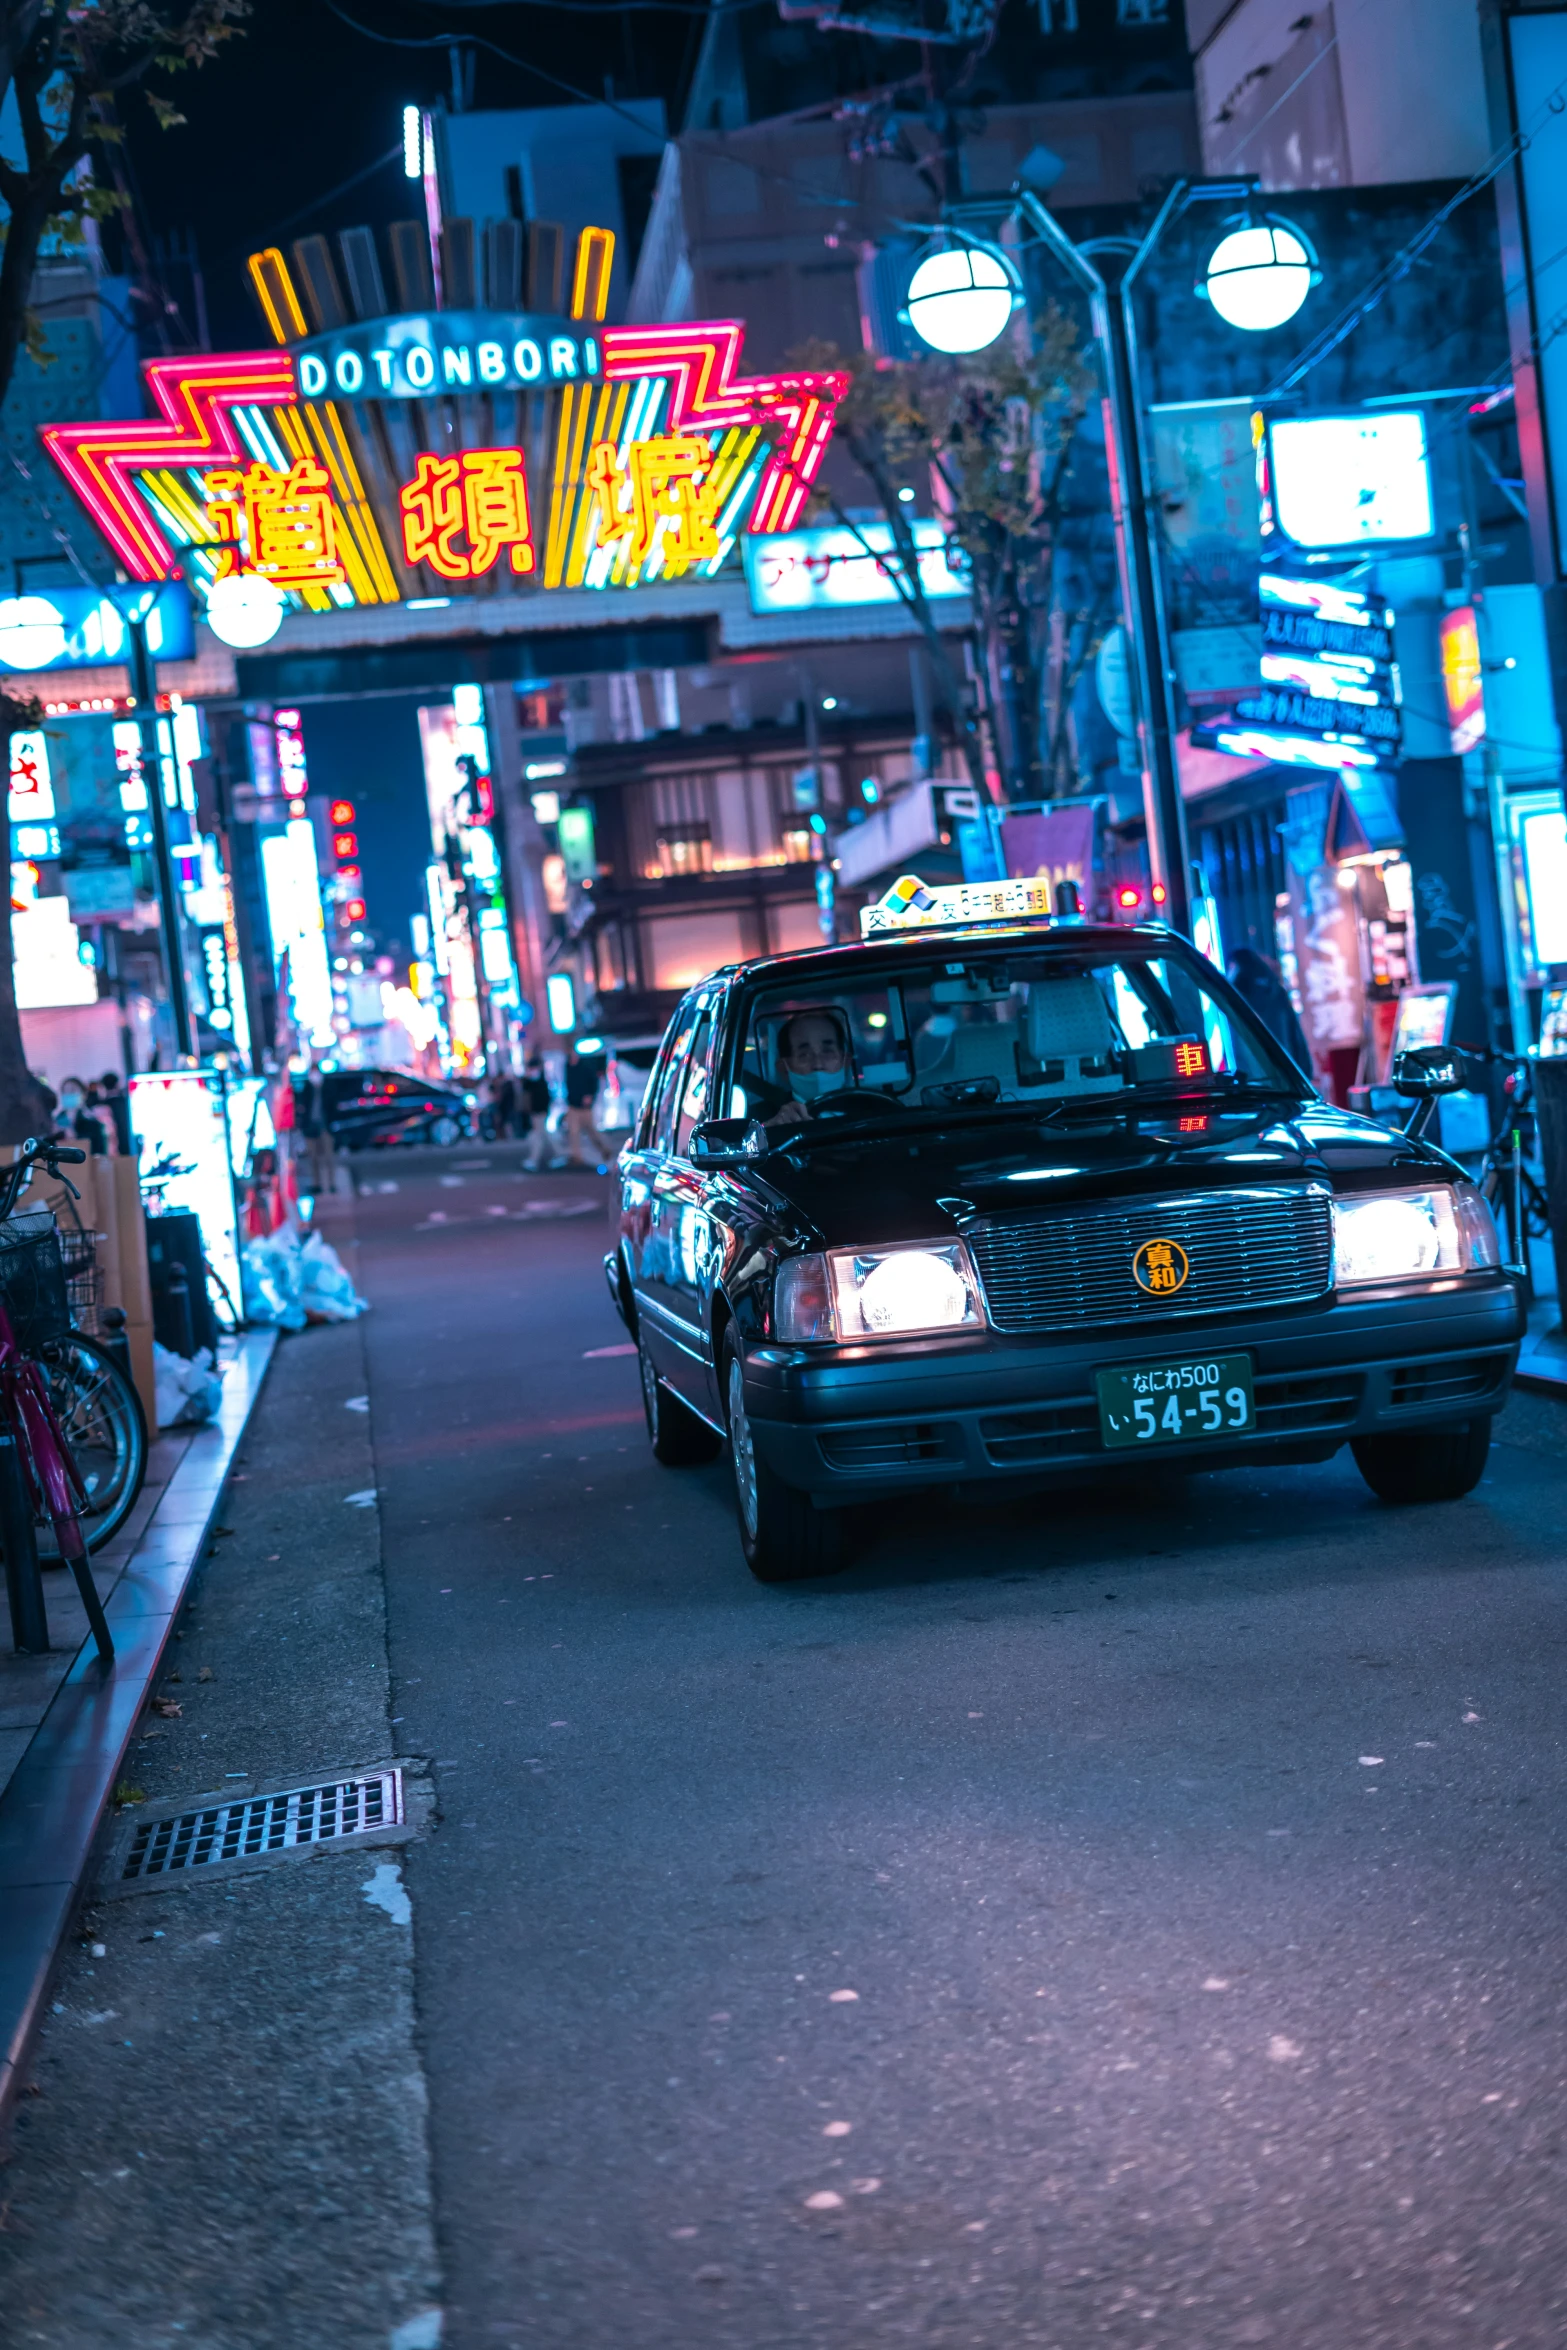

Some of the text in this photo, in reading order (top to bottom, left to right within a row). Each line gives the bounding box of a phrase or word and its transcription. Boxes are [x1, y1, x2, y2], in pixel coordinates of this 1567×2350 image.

[299, 337, 598, 397] DOTONBORI
[203, 435, 721, 590] 道頓堀
[1176, 1043, 1206, 1076] 車
[1146, 1243, 1177, 1289] 真和
[1133, 1387, 1248, 1438] 54-59
